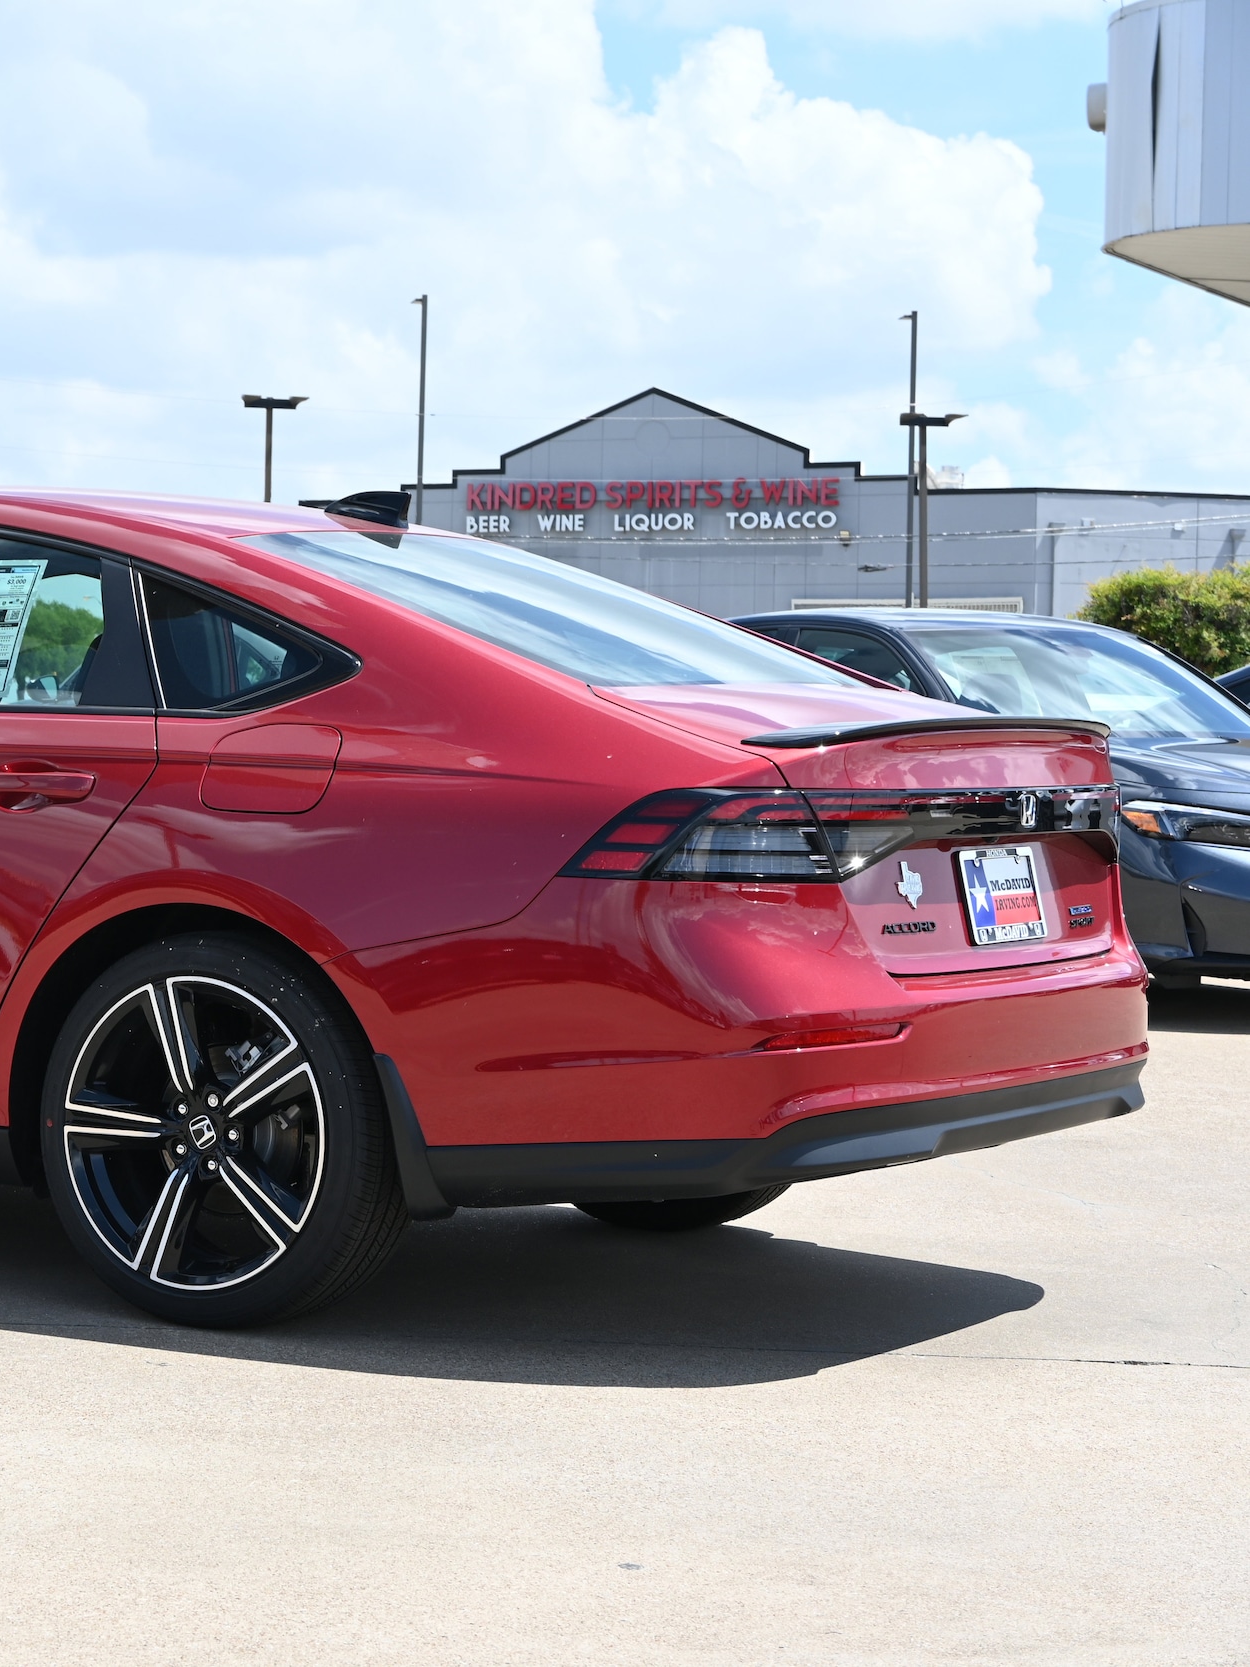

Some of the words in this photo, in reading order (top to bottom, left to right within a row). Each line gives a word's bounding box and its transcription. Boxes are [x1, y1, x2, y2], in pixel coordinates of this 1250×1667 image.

[465, 481, 597, 512] KINDRED
[604, 479, 723, 510] SPIRITS
[730, 477, 752, 508] &
[759, 477, 840, 508] WINE
[465, 515, 511, 534] BEER
[537, 513, 585, 533] WINE
[613, 512, 695, 532] LIQUOR
[725, 510, 838, 531] TOBACCO
[989, 877, 1032, 892] McDAVID
[994, 895, 1038, 911] IRVING.COM
[882, 921, 937, 935] ACCORD
[994, 923, 1029, 941] McDAVID
